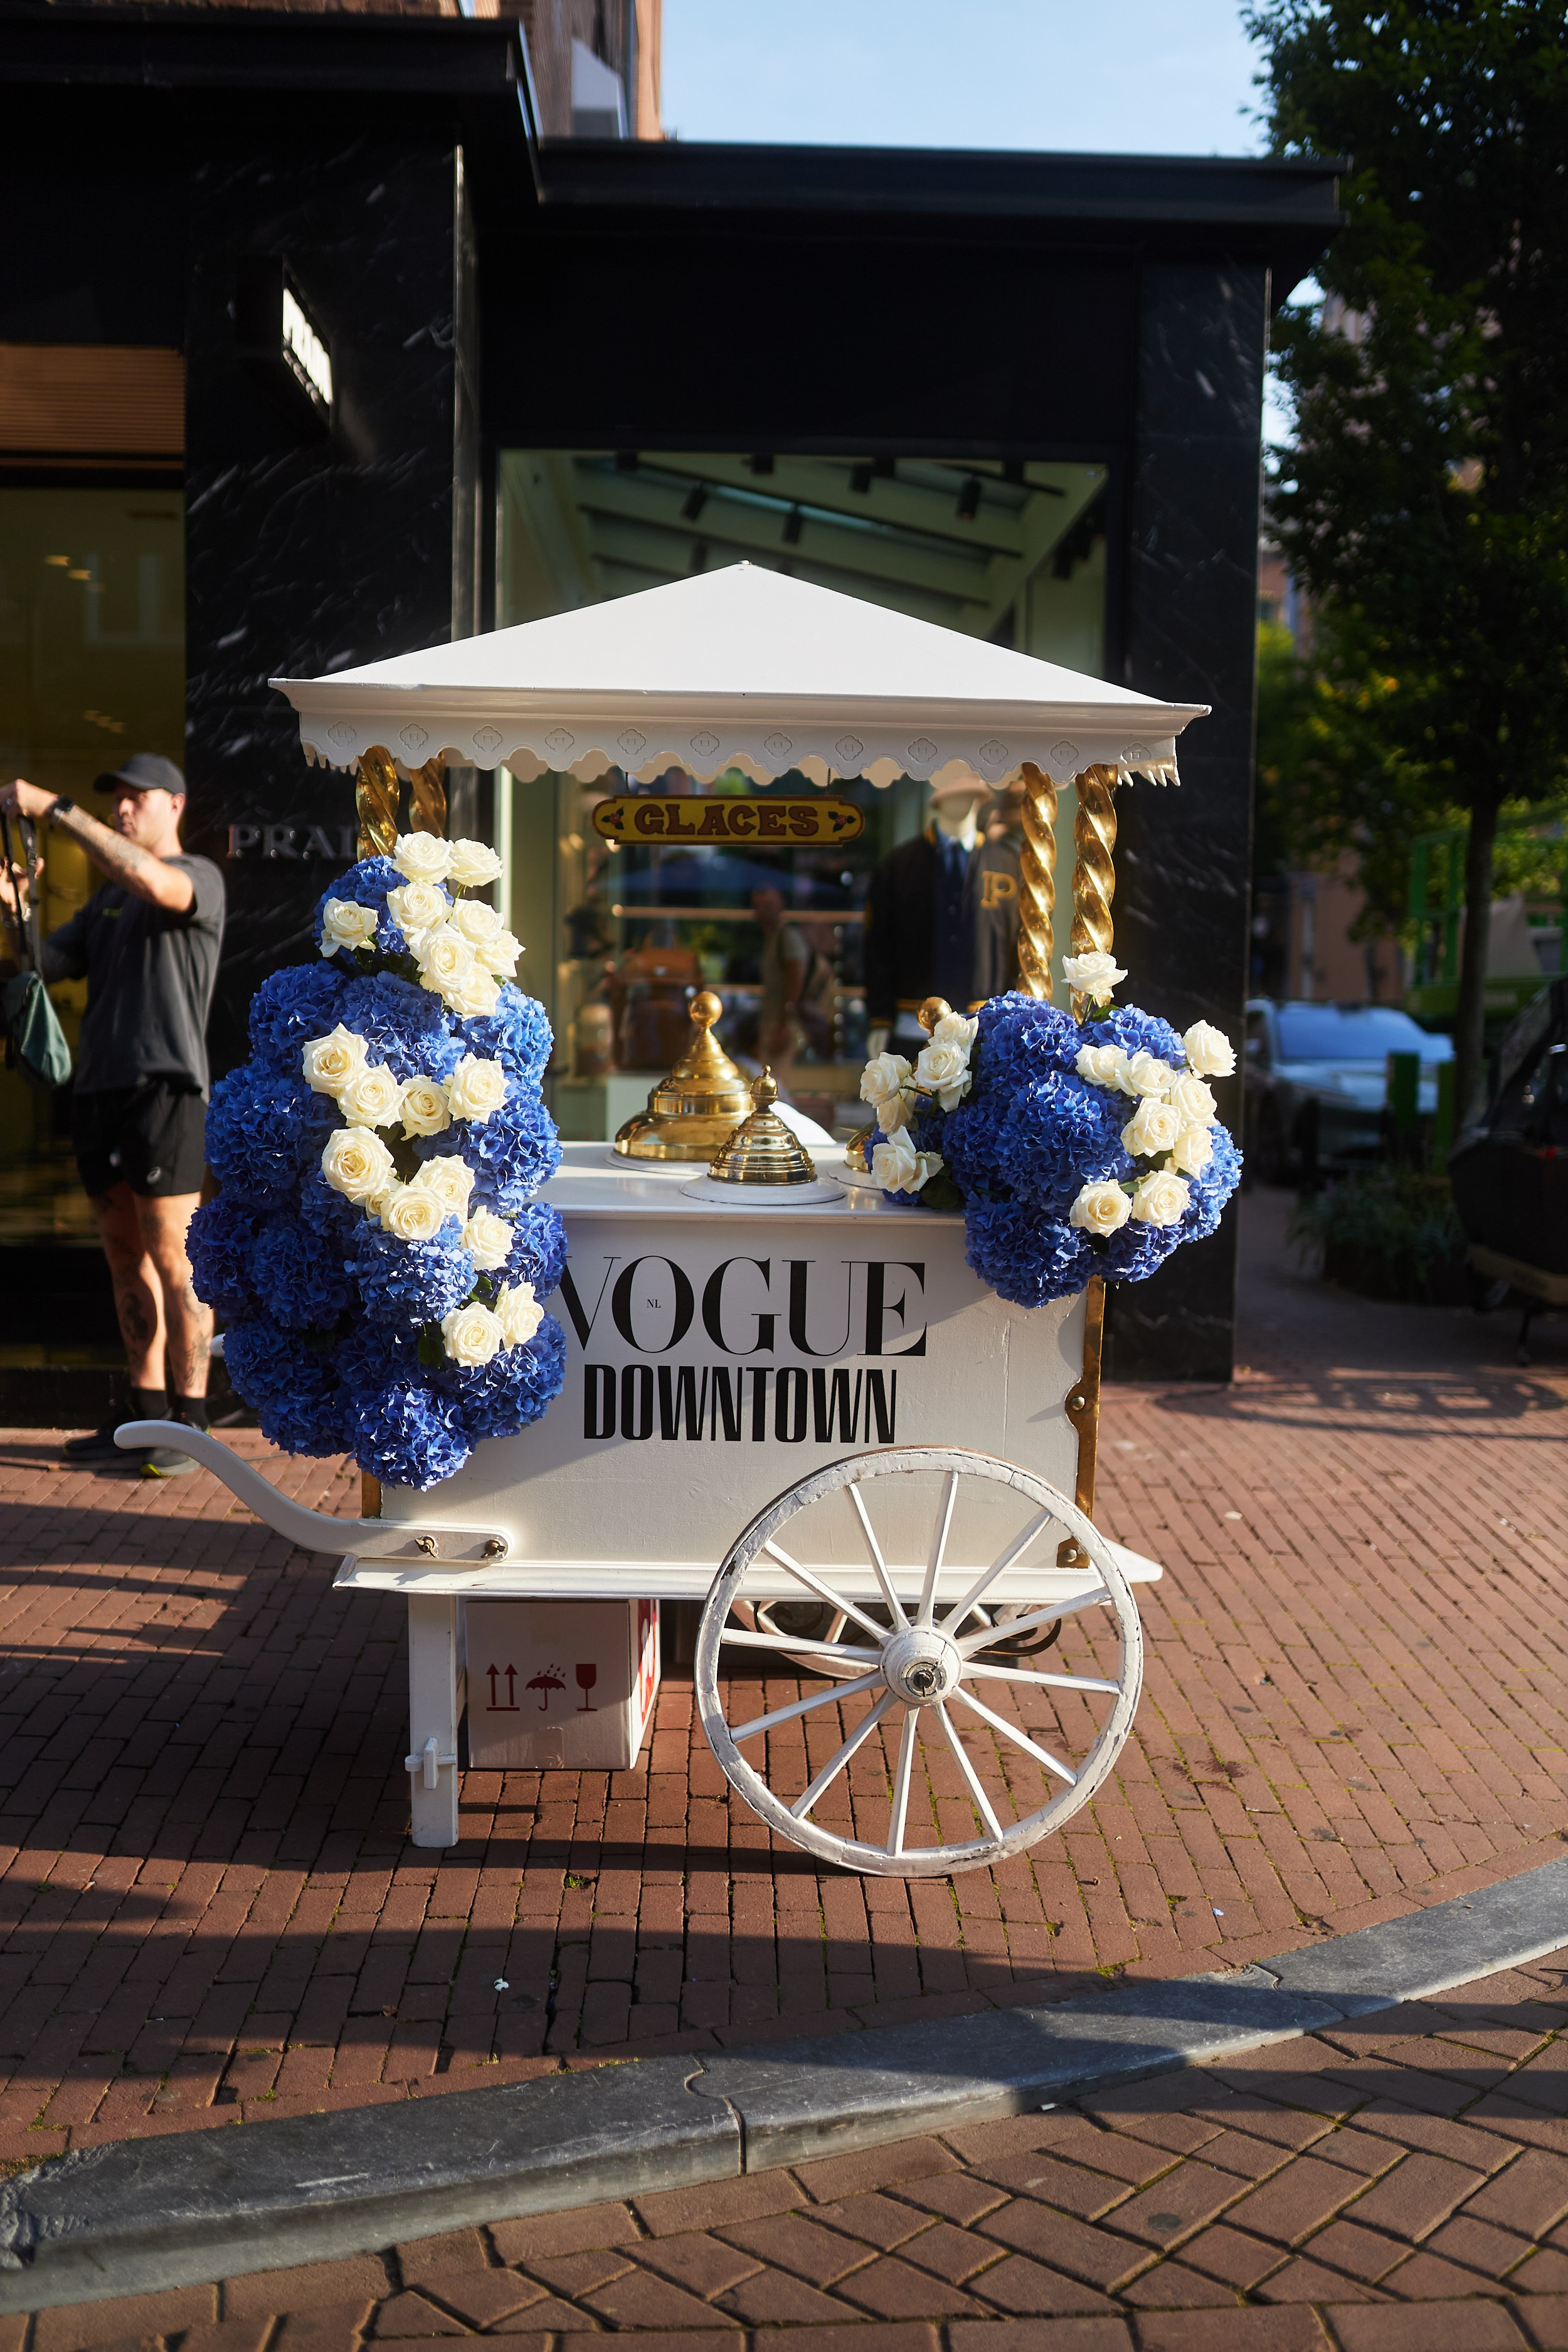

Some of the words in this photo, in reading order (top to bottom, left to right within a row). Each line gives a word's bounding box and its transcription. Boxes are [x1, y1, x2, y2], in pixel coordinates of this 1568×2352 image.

[634, 803, 819, 835] GLACES
[981, 870, 1017, 909] P
[559, 1256, 927, 1356] VOGUE
[647, 1299, 661, 1308] NL
[584, 1365, 896, 1443] DOWNTOWN
